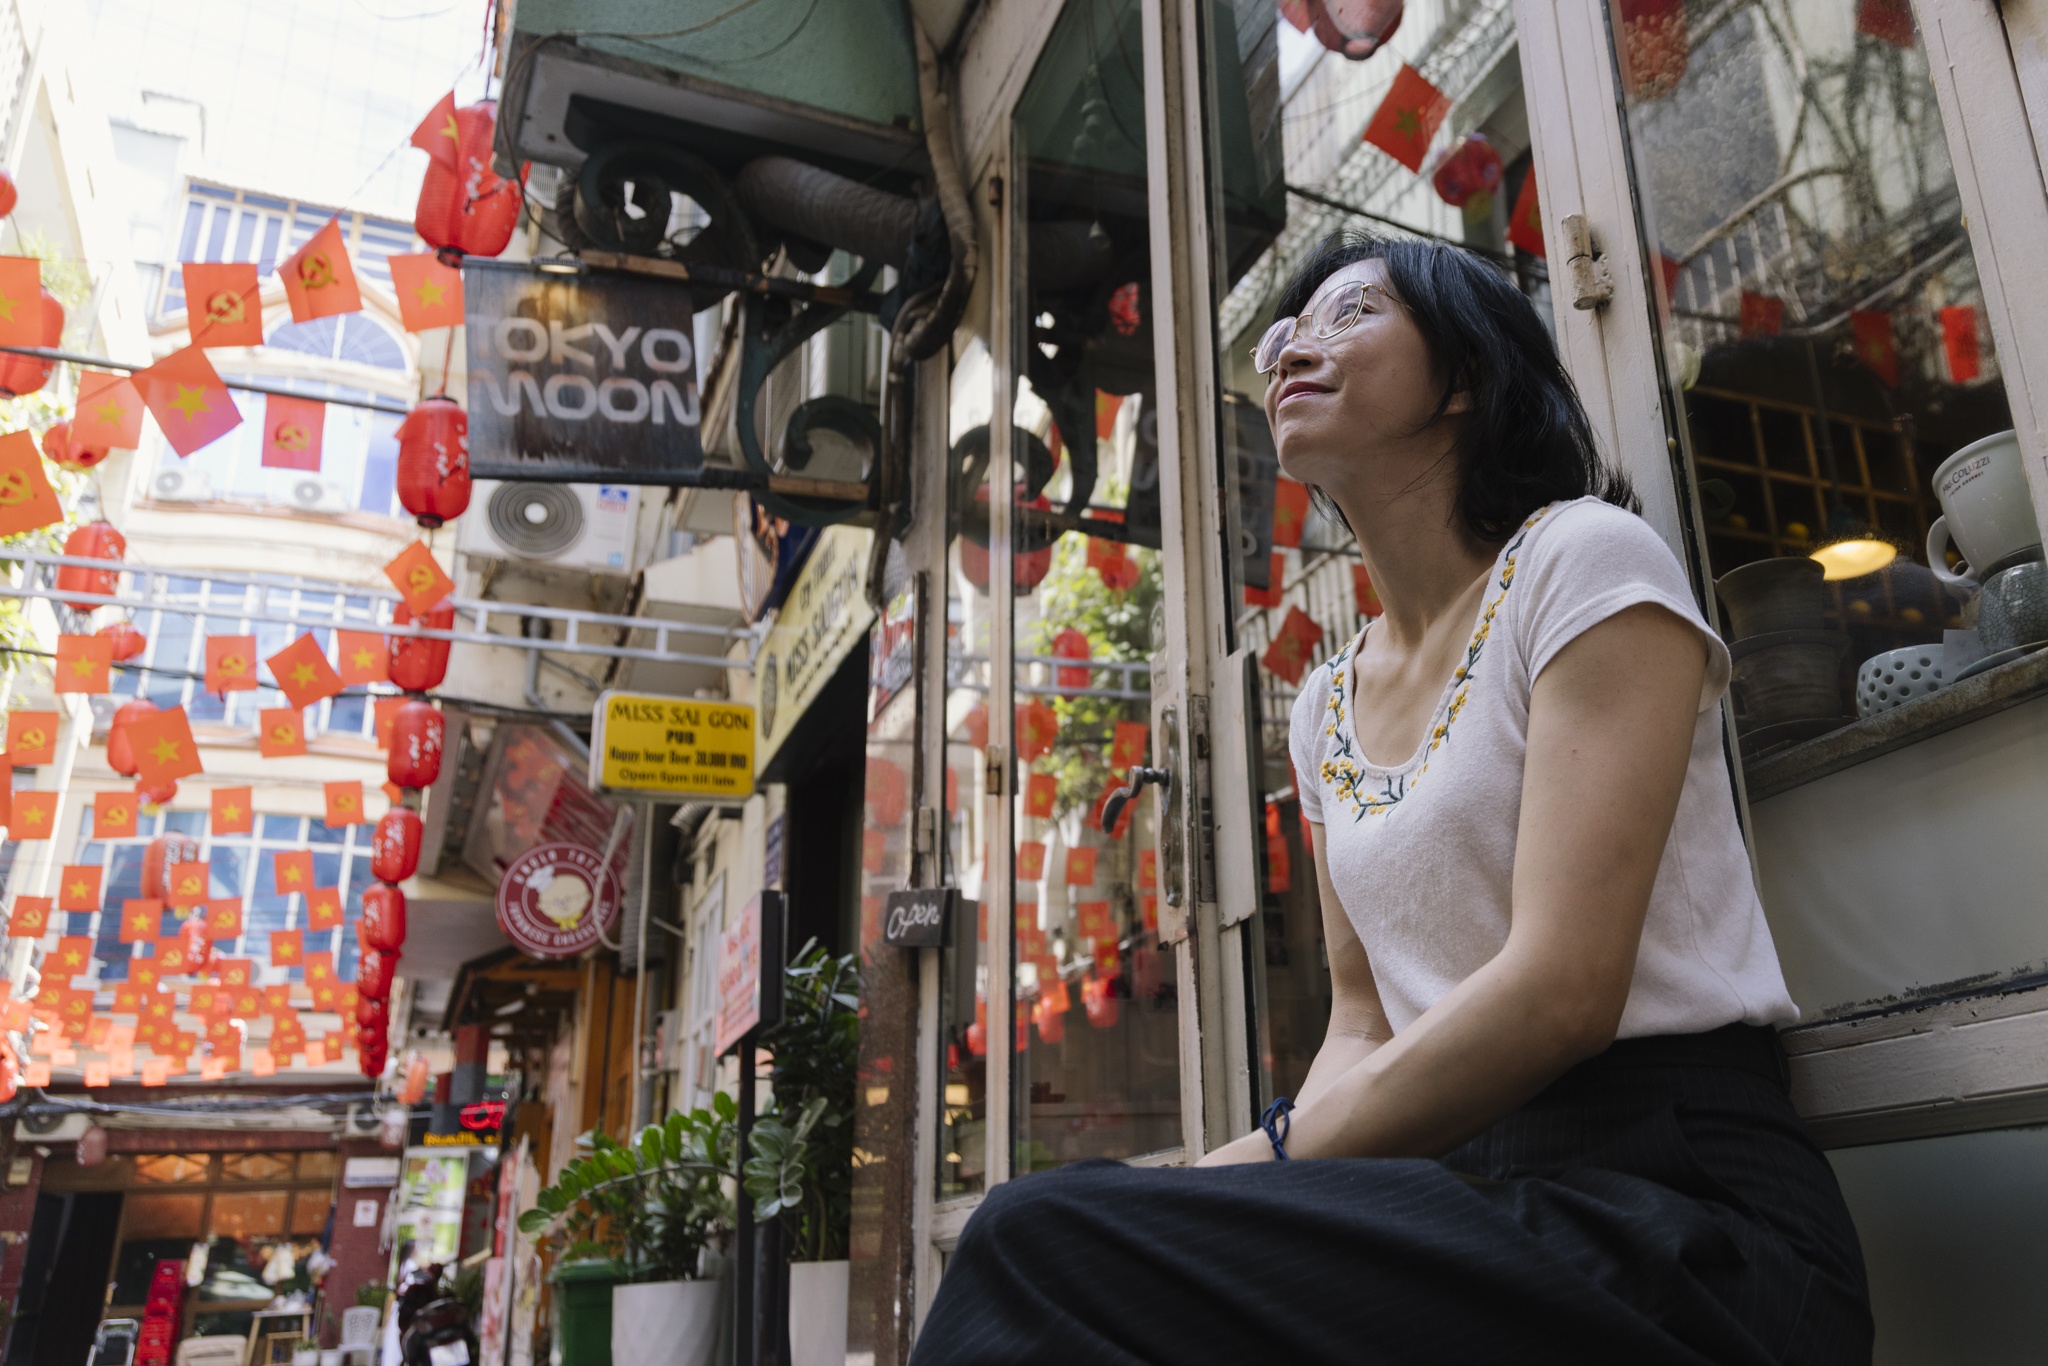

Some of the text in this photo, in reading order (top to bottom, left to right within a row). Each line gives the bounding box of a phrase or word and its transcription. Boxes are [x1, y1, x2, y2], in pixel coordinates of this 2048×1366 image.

[467, 313, 693, 374] TOKYO
[467, 367, 701, 427] MOON
[1952, 456, 1990, 484] COLUZZI
[611, 703, 749, 730] MISS SAI GON
[666, 729, 696, 745] PUB
[609, 746, 640, 763] Happy
[619, 768, 655, 783] Open
[887, 901, 942, 939] Open
